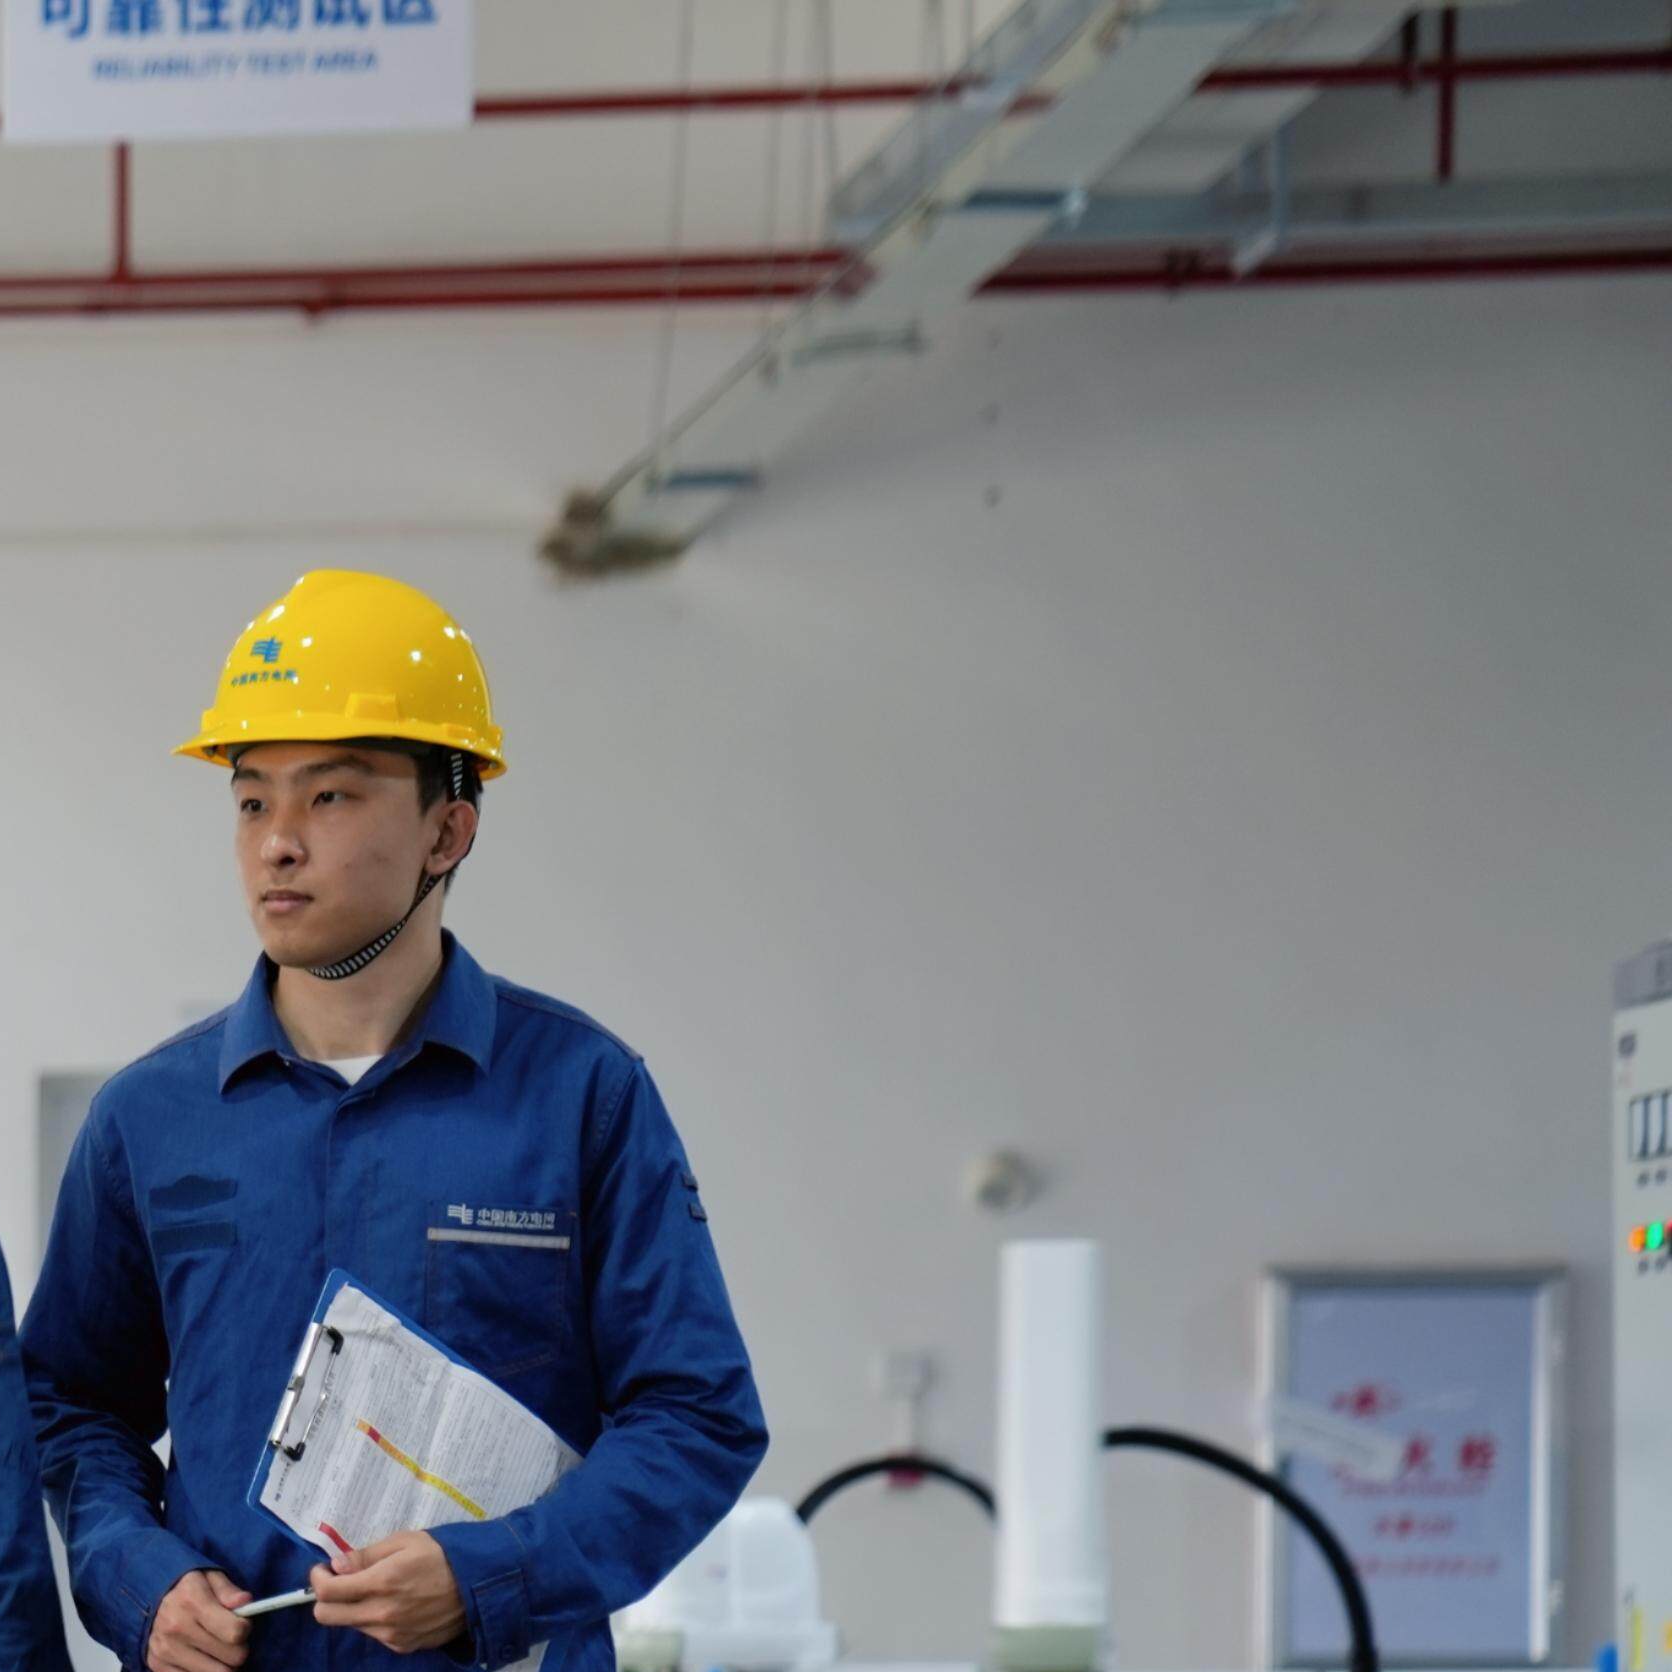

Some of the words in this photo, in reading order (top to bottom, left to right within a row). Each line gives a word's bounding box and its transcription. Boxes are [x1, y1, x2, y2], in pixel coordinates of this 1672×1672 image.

[92, 53, 239, 82] RELIABILITY
[247, 51, 306, 75] TEST
[312, 49, 379, 73] AREA
